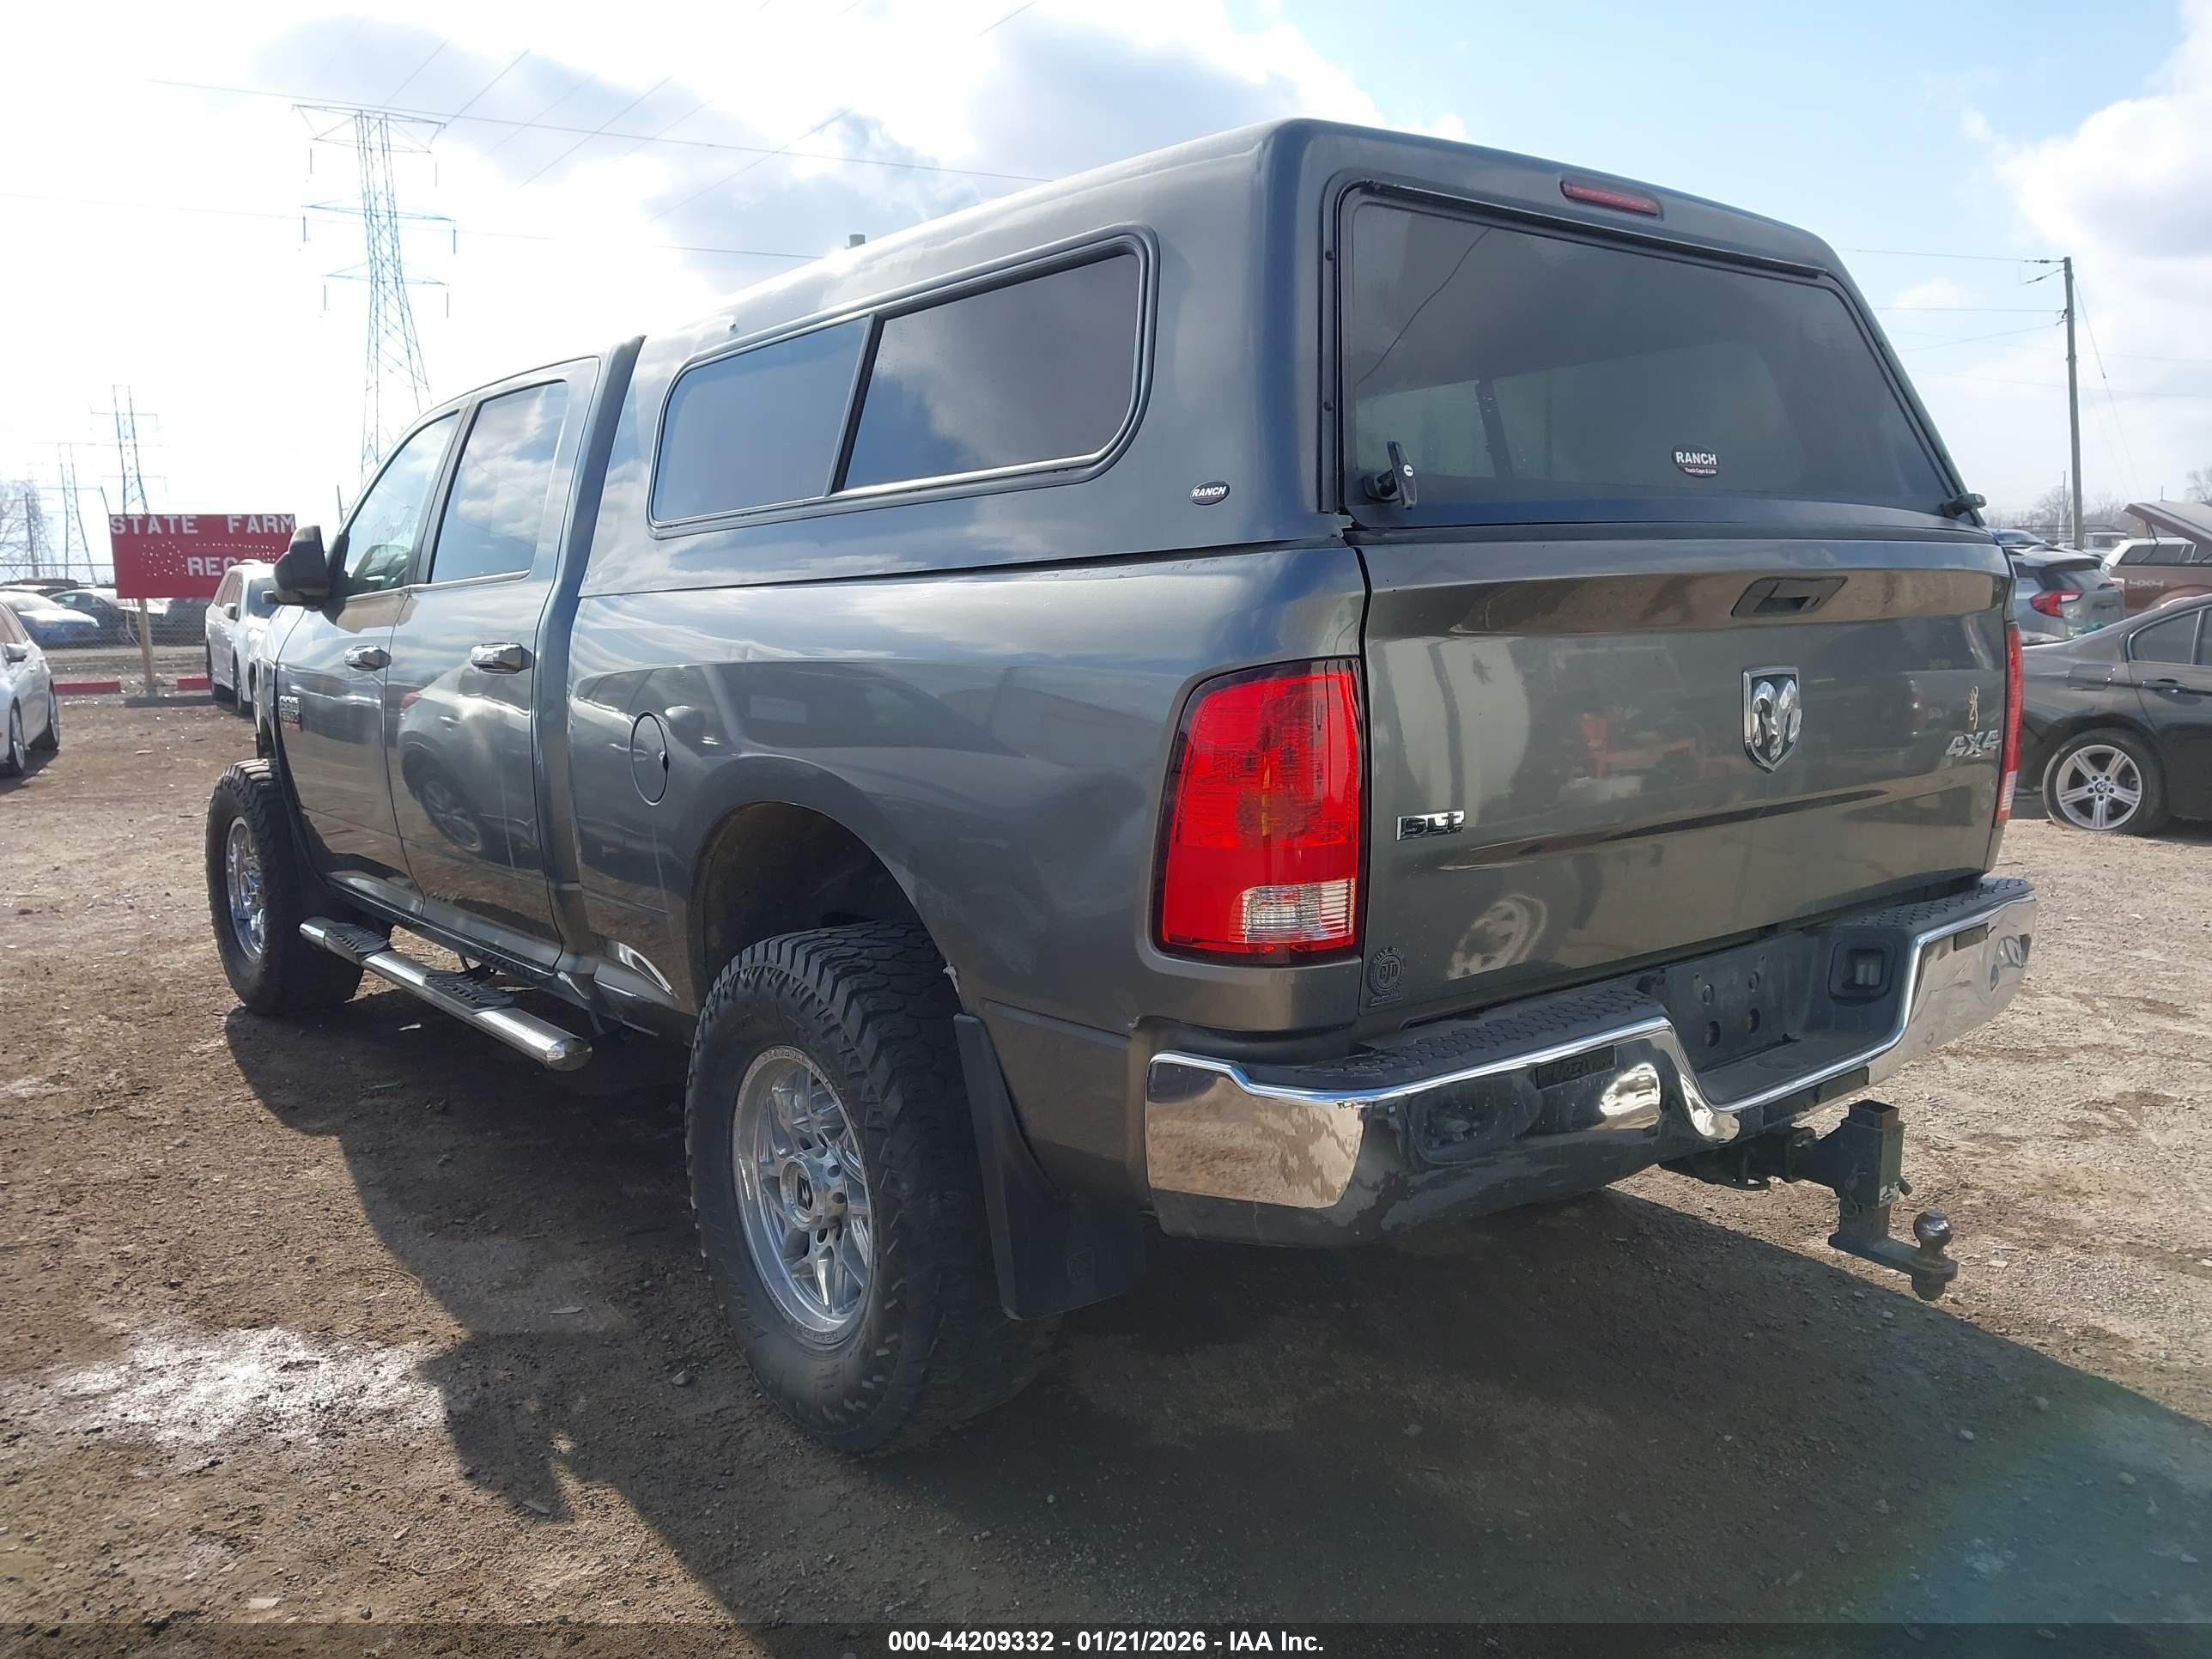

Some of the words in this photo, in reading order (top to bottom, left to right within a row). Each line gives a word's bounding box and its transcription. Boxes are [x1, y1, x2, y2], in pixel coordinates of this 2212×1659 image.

[1676, 451, 1717, 465] RANCH
[1192, 485, 1227, 497] RANCH
[110, 515, 198, 534] STATE
[227, 515, 295, 533] FARM
[1945, 729, 2002, 757] 4X4
